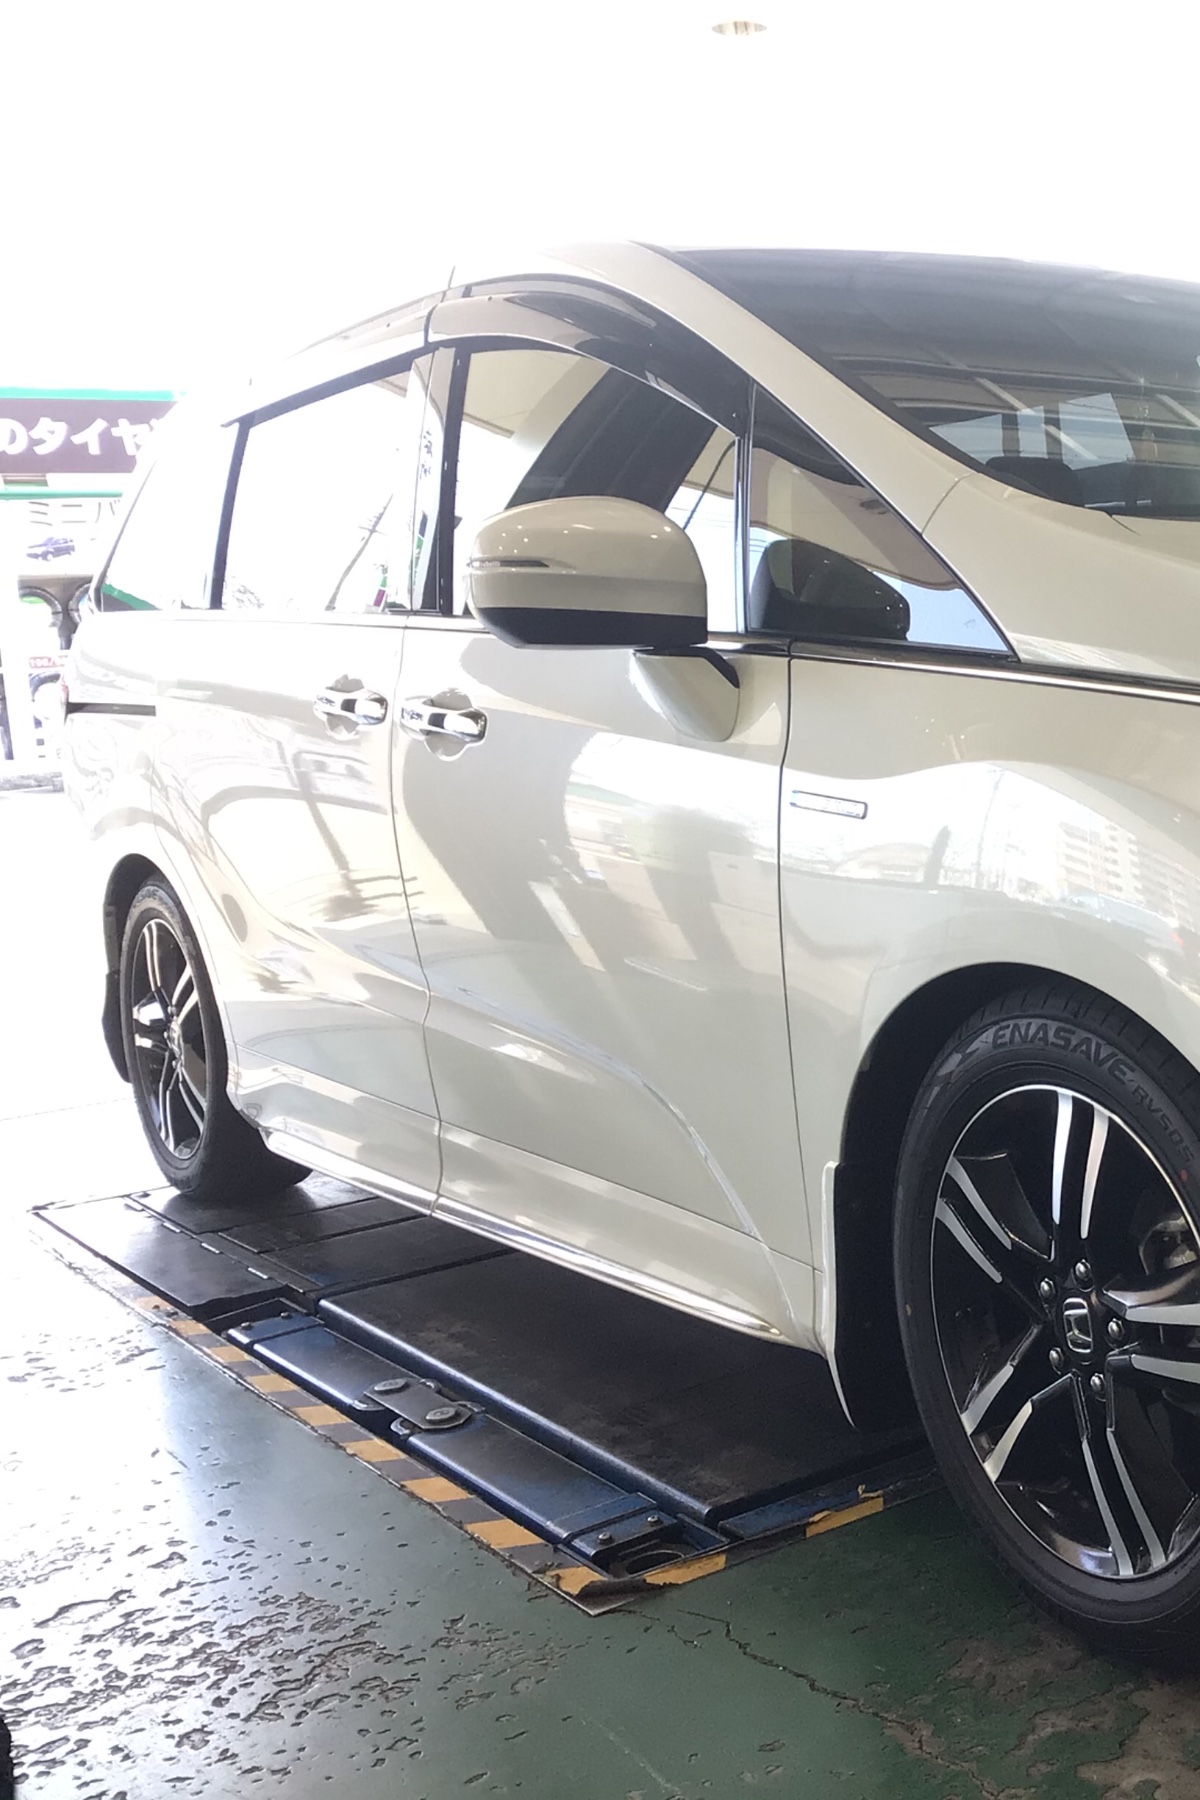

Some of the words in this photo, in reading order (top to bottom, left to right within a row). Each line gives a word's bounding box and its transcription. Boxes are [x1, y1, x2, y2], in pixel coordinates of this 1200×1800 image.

[0, 416, 158, 456] のタイヤ
[991, 1020, 1136, 1086] ENASAVE
